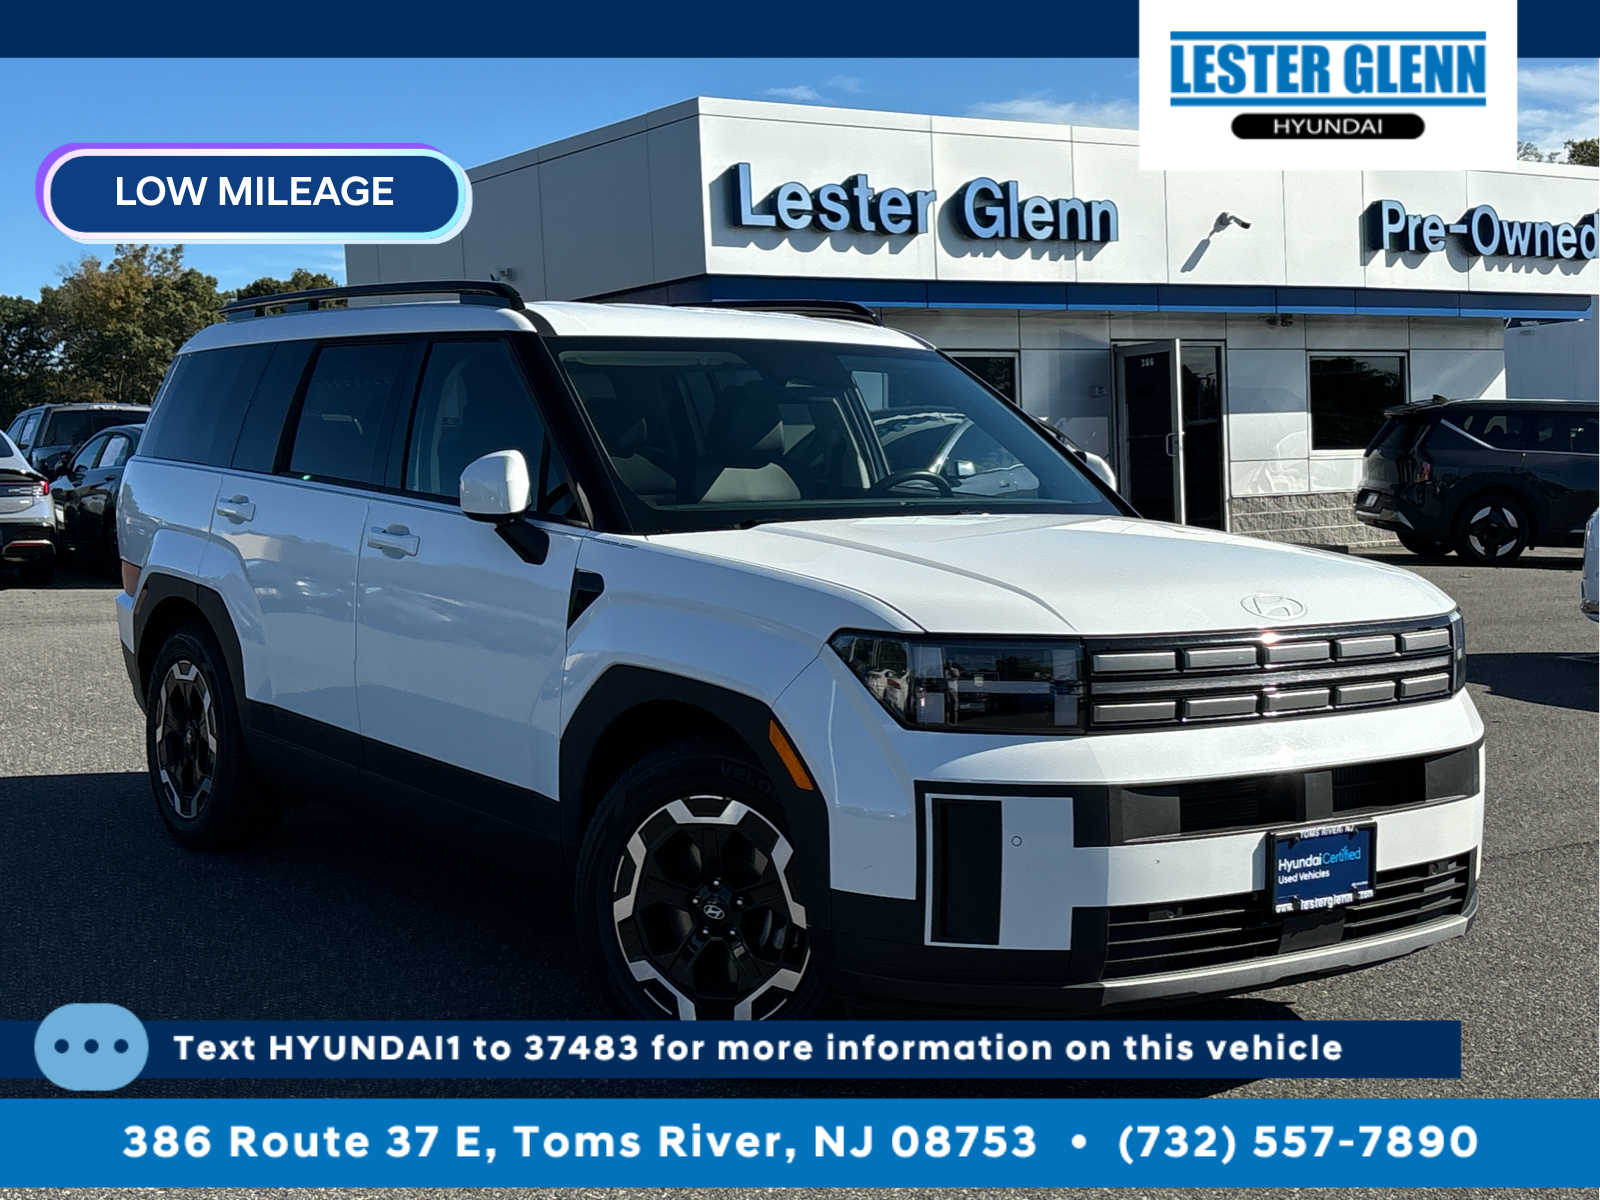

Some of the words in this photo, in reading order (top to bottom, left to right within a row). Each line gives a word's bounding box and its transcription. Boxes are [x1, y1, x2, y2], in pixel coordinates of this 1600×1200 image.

[735, 162, 937, 234] Lester
[961, 177, 1119, 242] Glenn
[1378, 200, 1600, 260] Pre-Owned
[1278, 872, 1298, 885] Used
[1299, 869, 1331, 881] Vehicles
